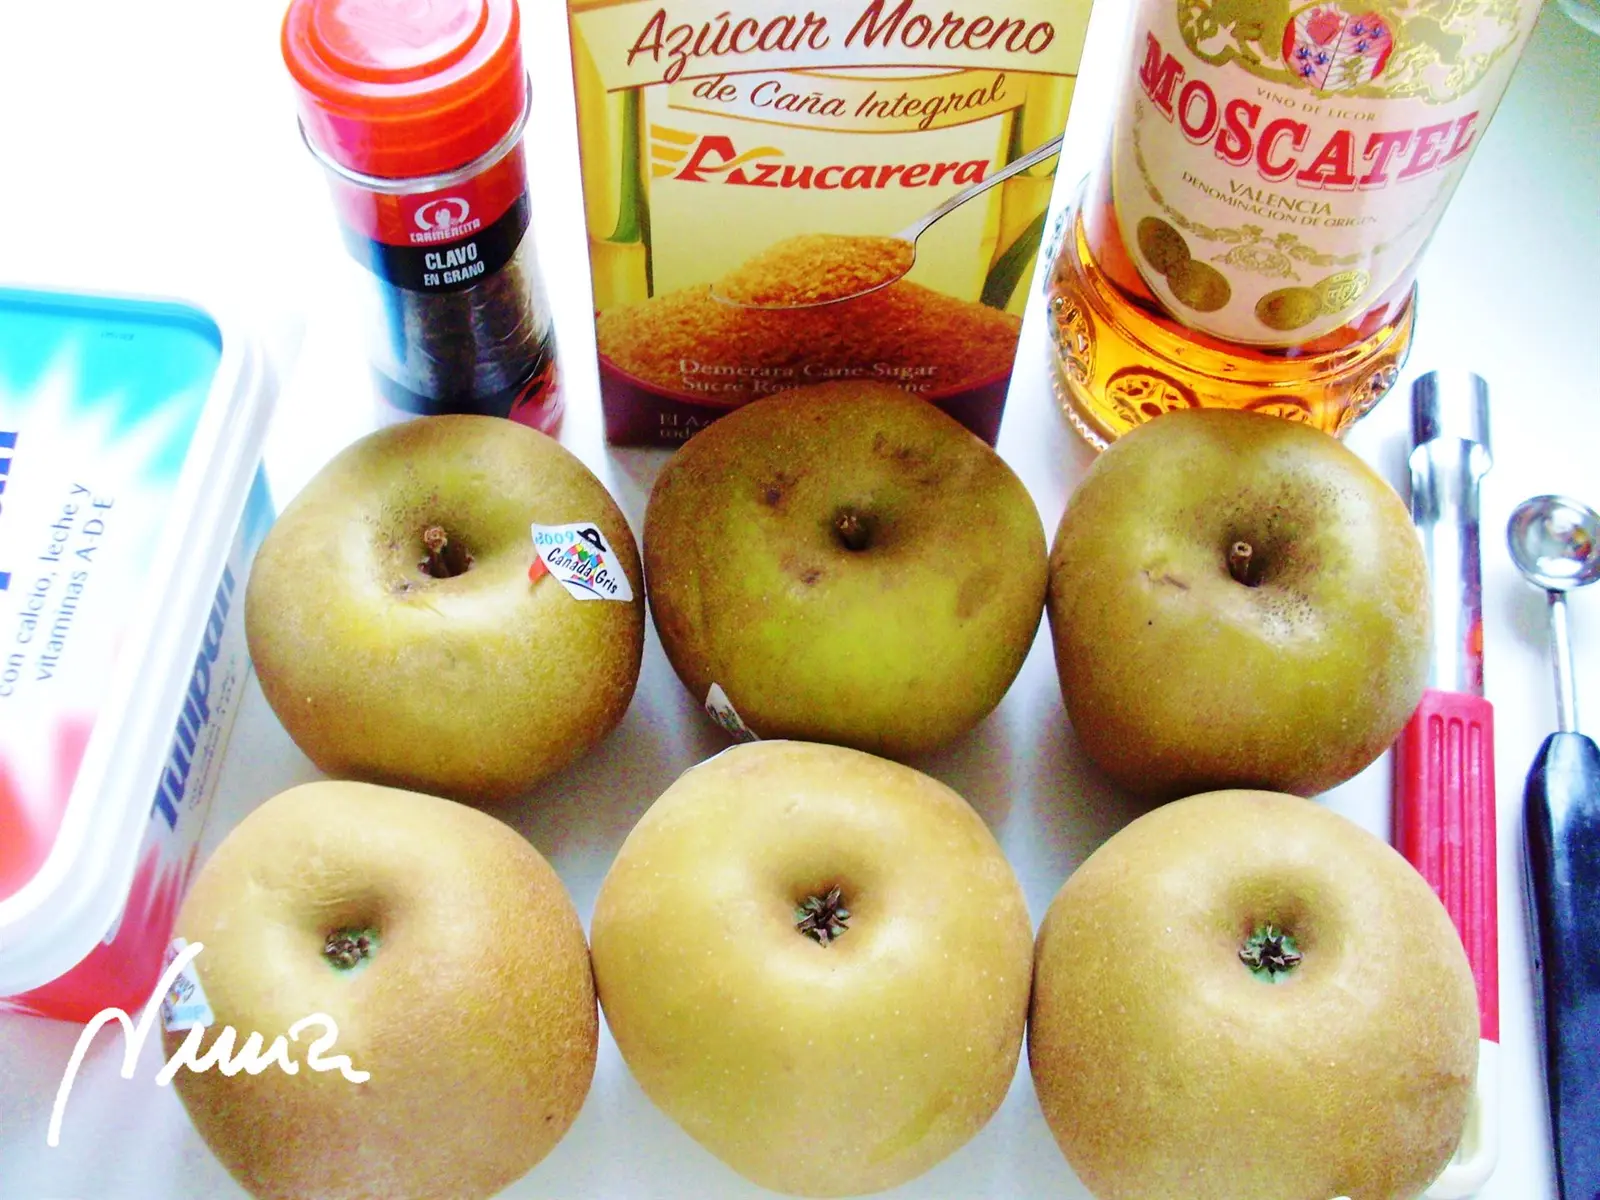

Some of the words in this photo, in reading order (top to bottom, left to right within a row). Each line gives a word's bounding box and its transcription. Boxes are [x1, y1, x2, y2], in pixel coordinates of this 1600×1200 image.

[626, 6, 829, 82] Azúcar
[844, 0, 1056, 55] Moreno
[692, 73, 738, 103] de
[750, 80, 846, 118] Caña
[854, 73, 1006, 130] Integral
[1138, 31, 1481, 193] MOSCATEL
[1257, 86, 1296, 109] VINO
[1301, 103, 1322, 116] DE
[1327, 107, 1378, 122] LICOR
[673, 135, 991, 189] Azucarera
[1228, 178, 1333, 216] VALENCIA
[1300, 215, 1323, 227] DE
[423, 272, 440, 287] EN
[443, 260, 486, 285] GRANO
[424, 242, 479, 271] CLAVO
[679, 358, 794, 377] Demerara
[803, 362, 865, 377] Cane
[870, 361, 939, 379] Sugar
[0, 651, 26, 698] con
[16, 571, 59, 644] calcio,
[38, 503, 80, 562] leche
[69, 482, 92, 499] y
[546, 547, 593, 578] Canada
[594, 569, 618, 594] Gris
[35, 570, 90, 682] vitaminas
